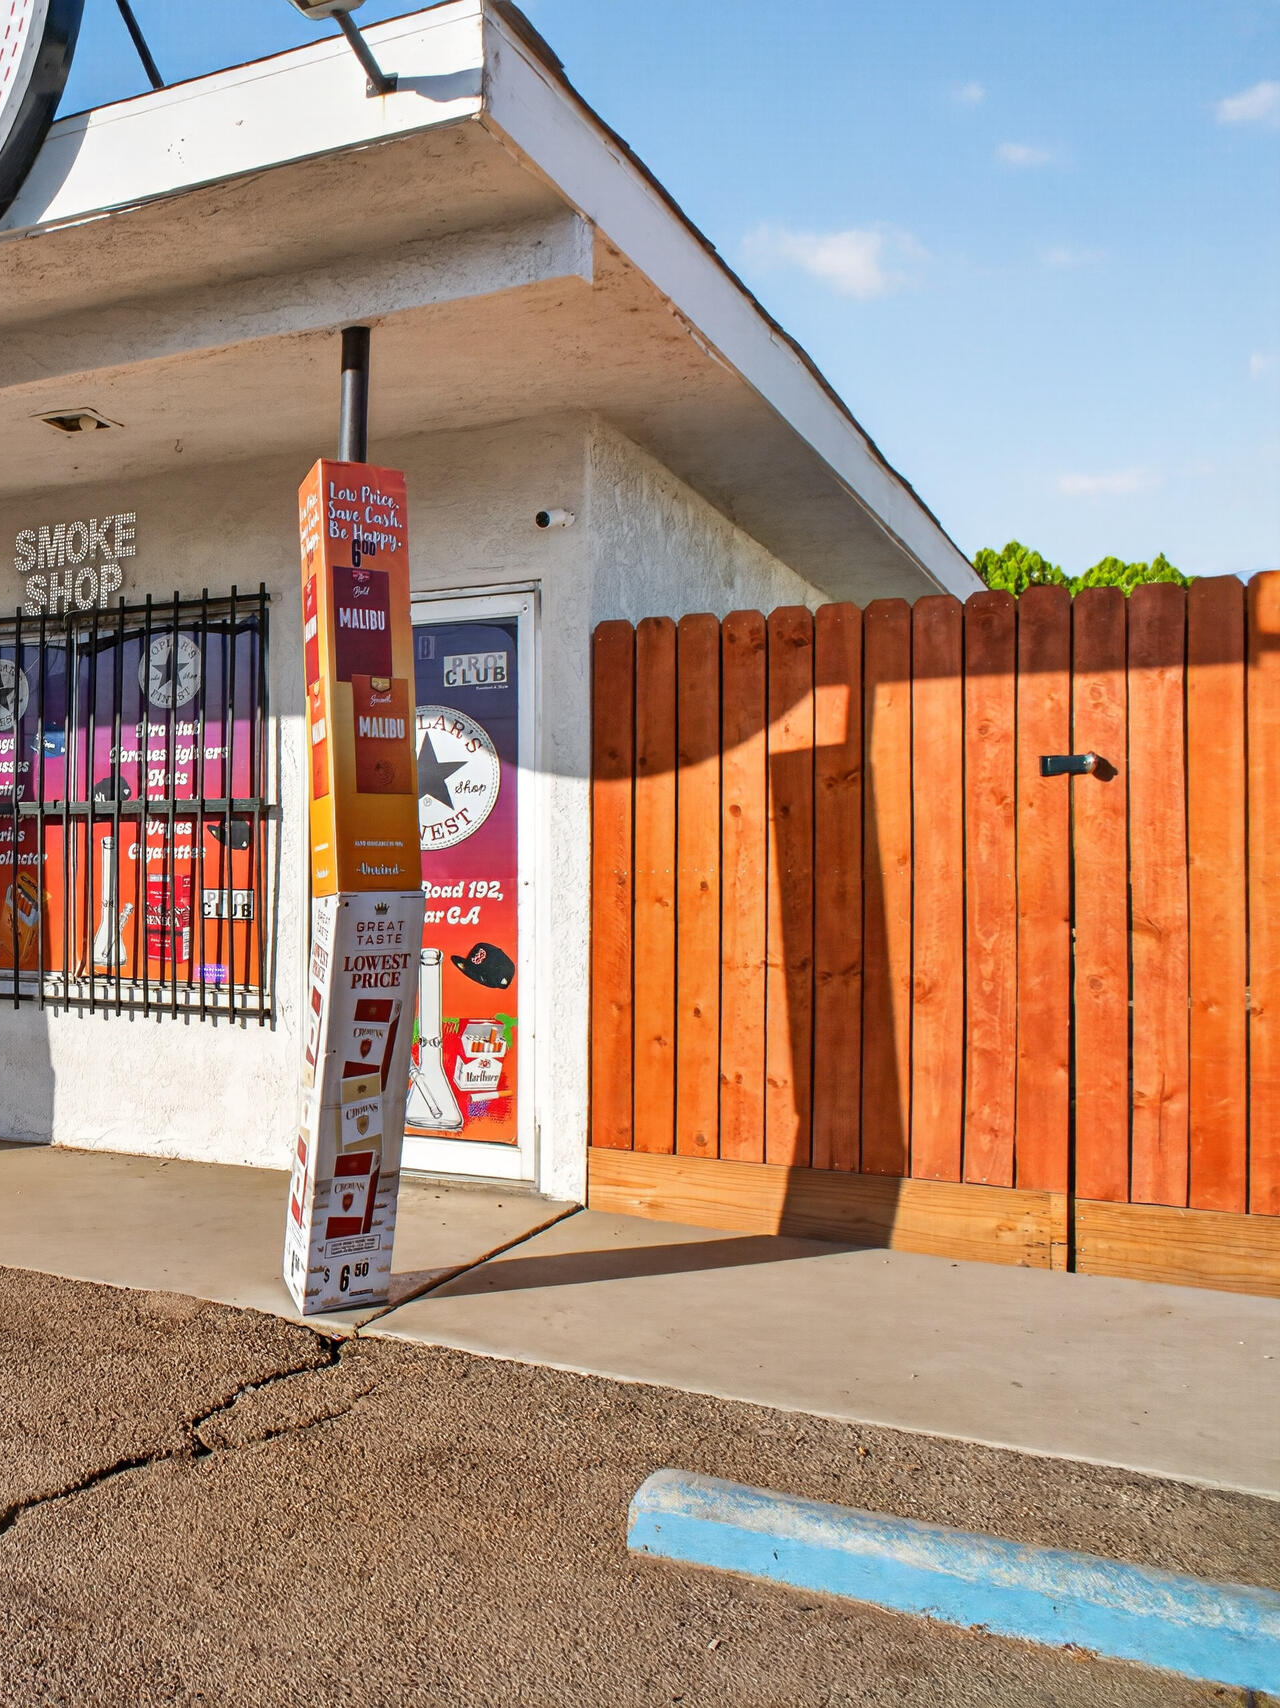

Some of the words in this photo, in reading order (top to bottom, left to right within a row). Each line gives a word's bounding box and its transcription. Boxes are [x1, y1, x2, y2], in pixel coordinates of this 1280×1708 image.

[329, 481, 357, 503] Low
[327, 500, 361, 522] Save
[364, 505, 403, 529] Cash.
[329, 519, 349, 540] Be
[13, 511, 136, 571] SMOKE
[24, 563, 123, 617] SHOP
[339, 606, 386, 631] MALIBU
[445, 666, 506, 686] CLUB
[358, 715, 405, 740] MALIBU
[454, 779, 487, 796] Shop
[468, 880, 504, 901] 192,
[446, 906, 482, 925] CA
[356, 920, 405, 933] GREAT
[356, 933, 403, 946] TASTE
[343, 952, 412, 972] LOWEST
[349, 971, 402, 990] PRICE
[346, 1102, 379, 1120] CROWNS
